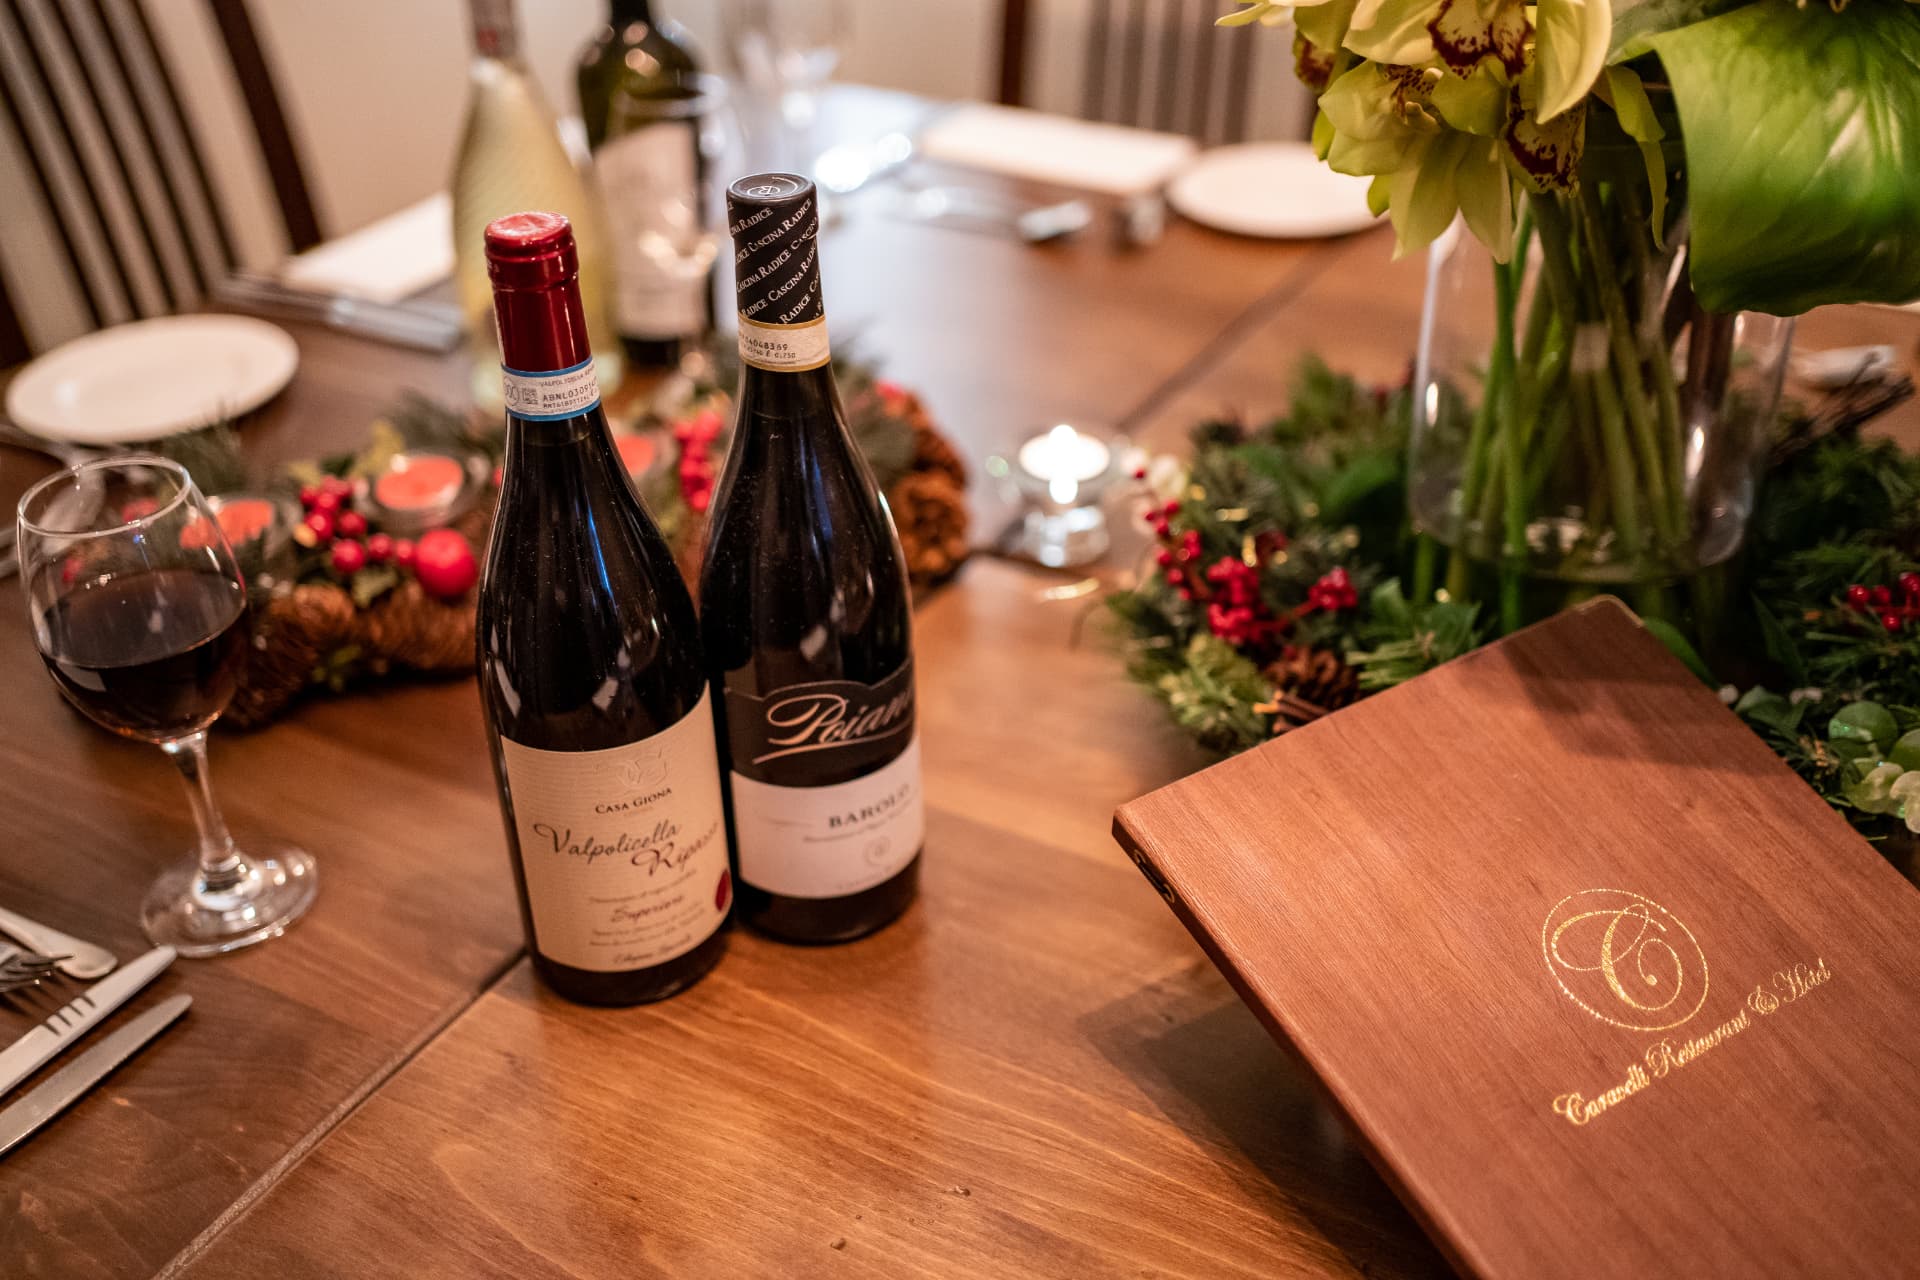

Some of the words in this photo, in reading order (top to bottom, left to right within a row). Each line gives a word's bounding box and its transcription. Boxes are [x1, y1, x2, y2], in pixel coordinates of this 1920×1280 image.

[740, 207, 774, 231] RADICE
[749, 228, 784, 252] CASCINA
[783, 198, 812, 231] RADICE
[758, 249, 792, 279] RADICE
[768, 271, 804, 302] CASCINA
[779, 293, 812, 324] RADICE
[595, 801, 629, 814] CASA
[828, 782, 911, 829] BAROLO
[533, 818, 680, 865] Valpolicella
[1645, 1008, 1751, 1078] Restaurant
[1772, 957, 1831, 1003] Hotel
